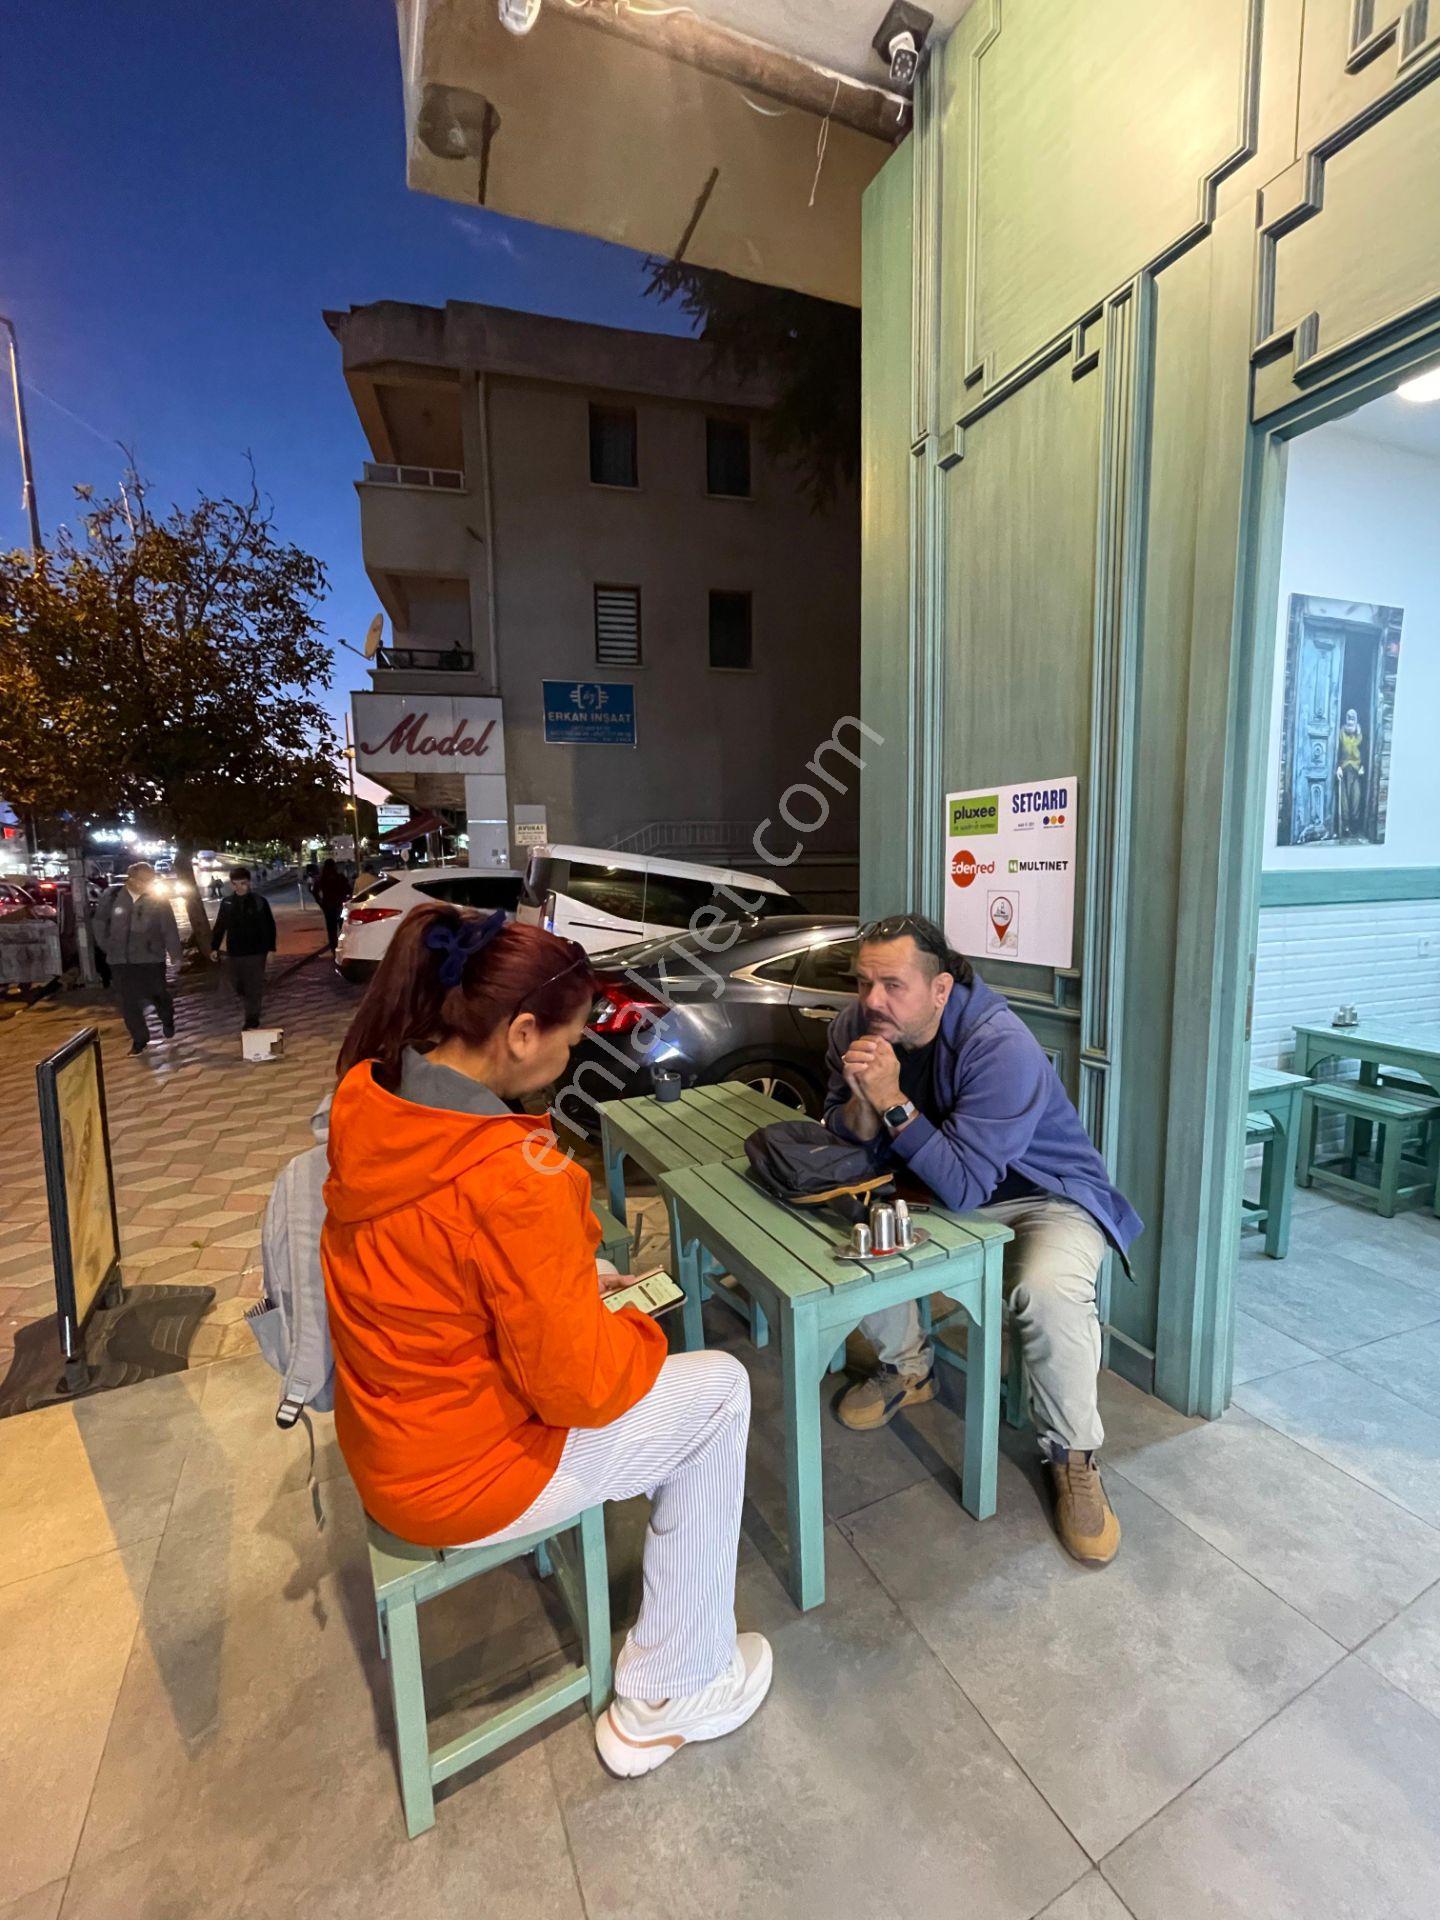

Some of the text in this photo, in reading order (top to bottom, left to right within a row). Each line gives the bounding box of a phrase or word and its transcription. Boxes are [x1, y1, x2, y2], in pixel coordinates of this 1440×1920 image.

[548, 711, 588, 721] ERKAN
[360, 712, 497, 757] Model
[1012, 788, 1068, 814] SETCARD
[953, 806, 996, 824] pluxee
[951, 860, 995, 875] Edenred
[1019, 860, 1069, 872] MULTINET
